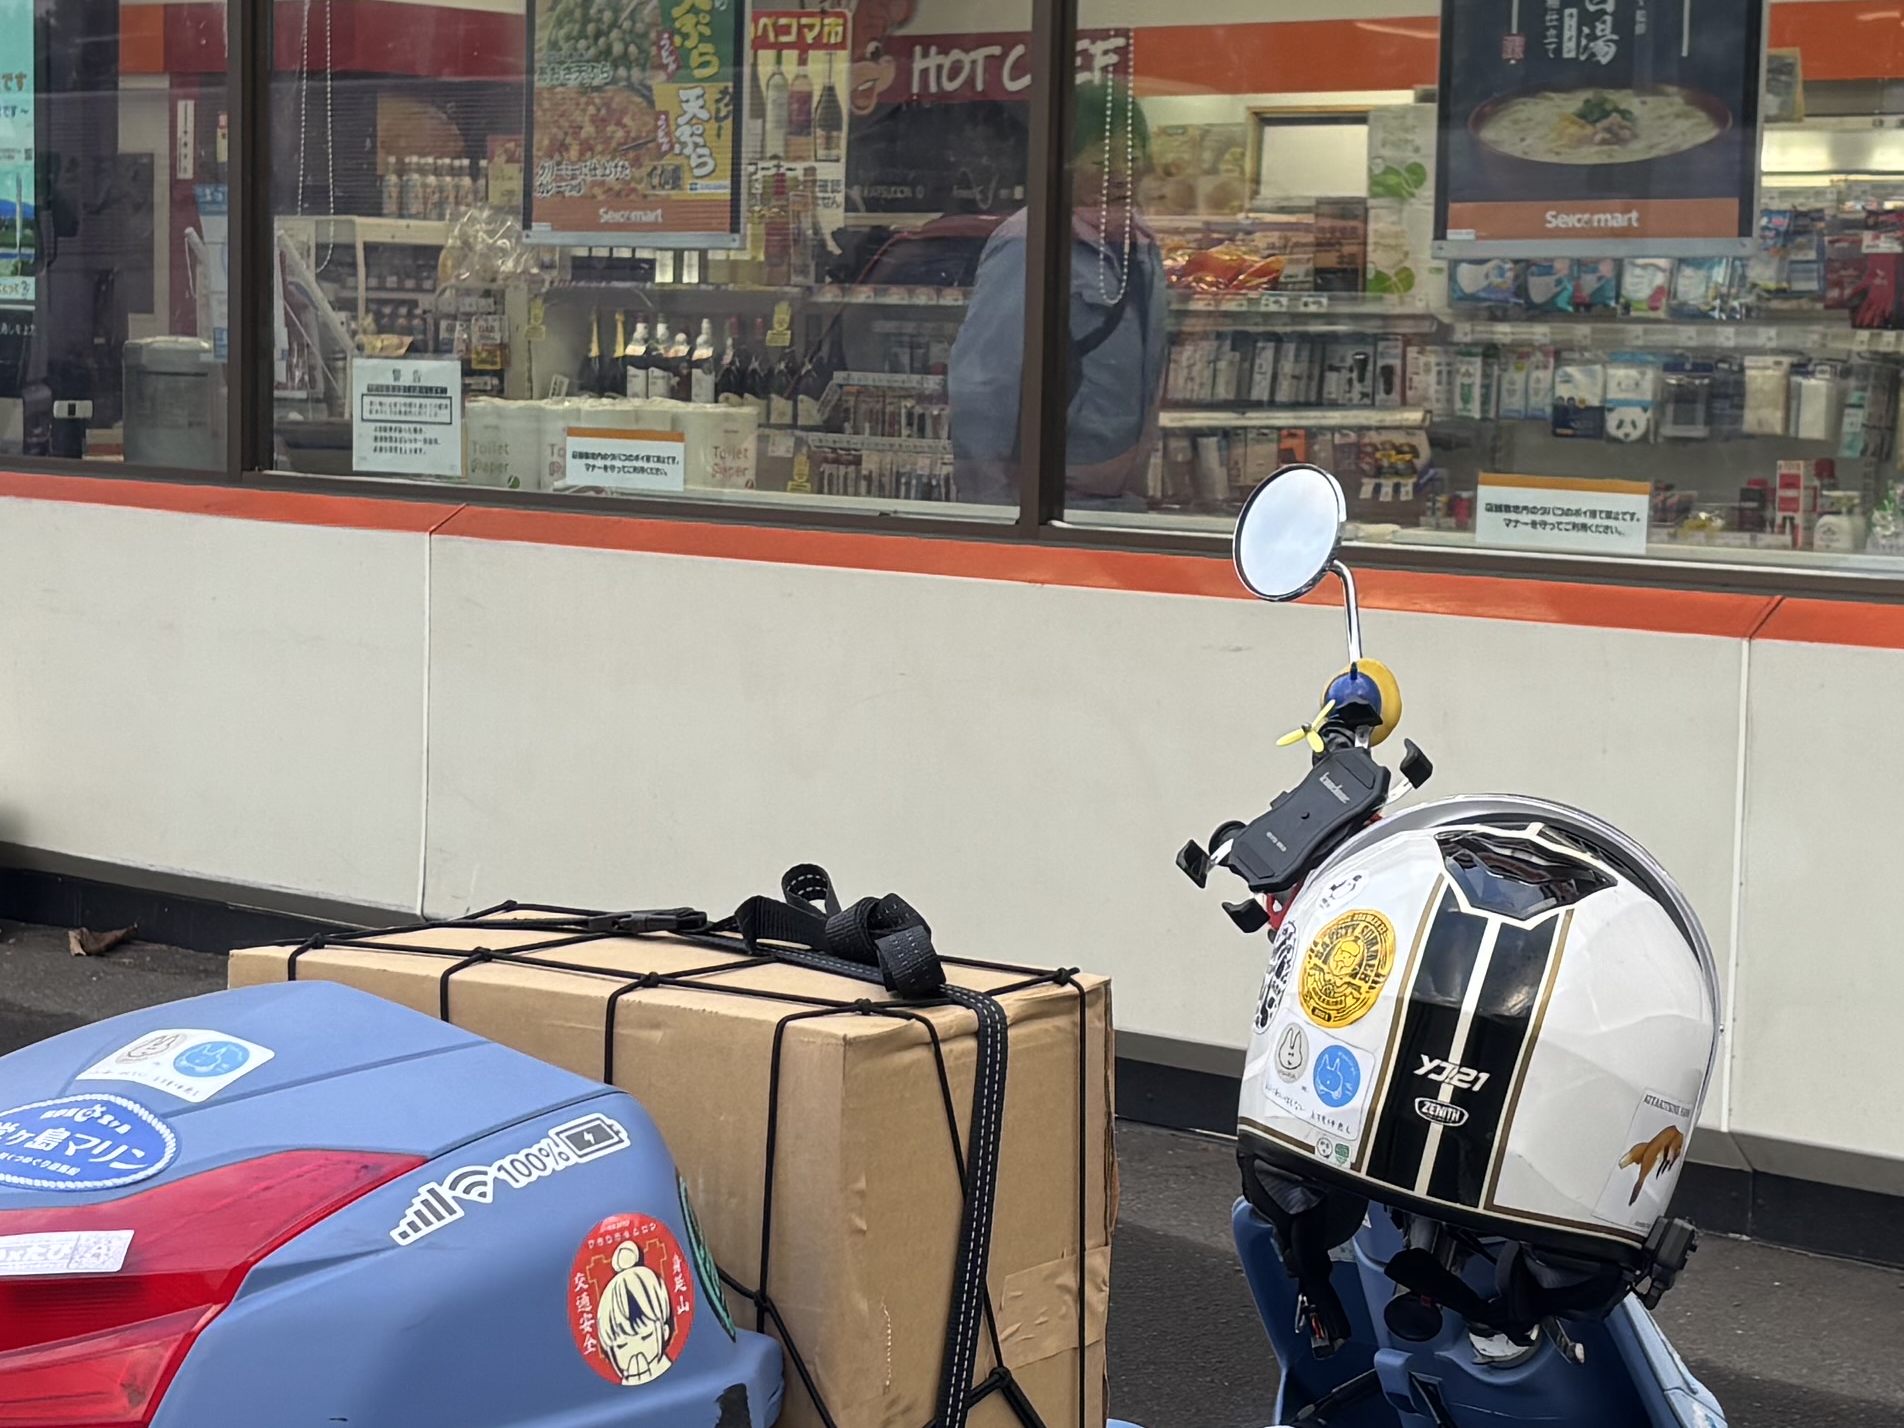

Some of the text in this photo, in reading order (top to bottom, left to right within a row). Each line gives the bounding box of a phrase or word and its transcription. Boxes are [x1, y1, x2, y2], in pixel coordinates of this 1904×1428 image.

[911, 44, 1002, 94] HOT
[673, 86, 717, 178] 天ぷら
[598, 207, 664, 224] Seicomart
[1545, 209, 1640, 230] Seicomart
[473, 441, 510, 456] Toilet
[711, 444, 749, 461] Toilet
[472, 459, 510, 474] Paper
[1420, 1101, 1463, 1123] ZENITH
[496, 1138, 571, 1185] 100%
[574, 1271, 598, 1356] 交通安全
